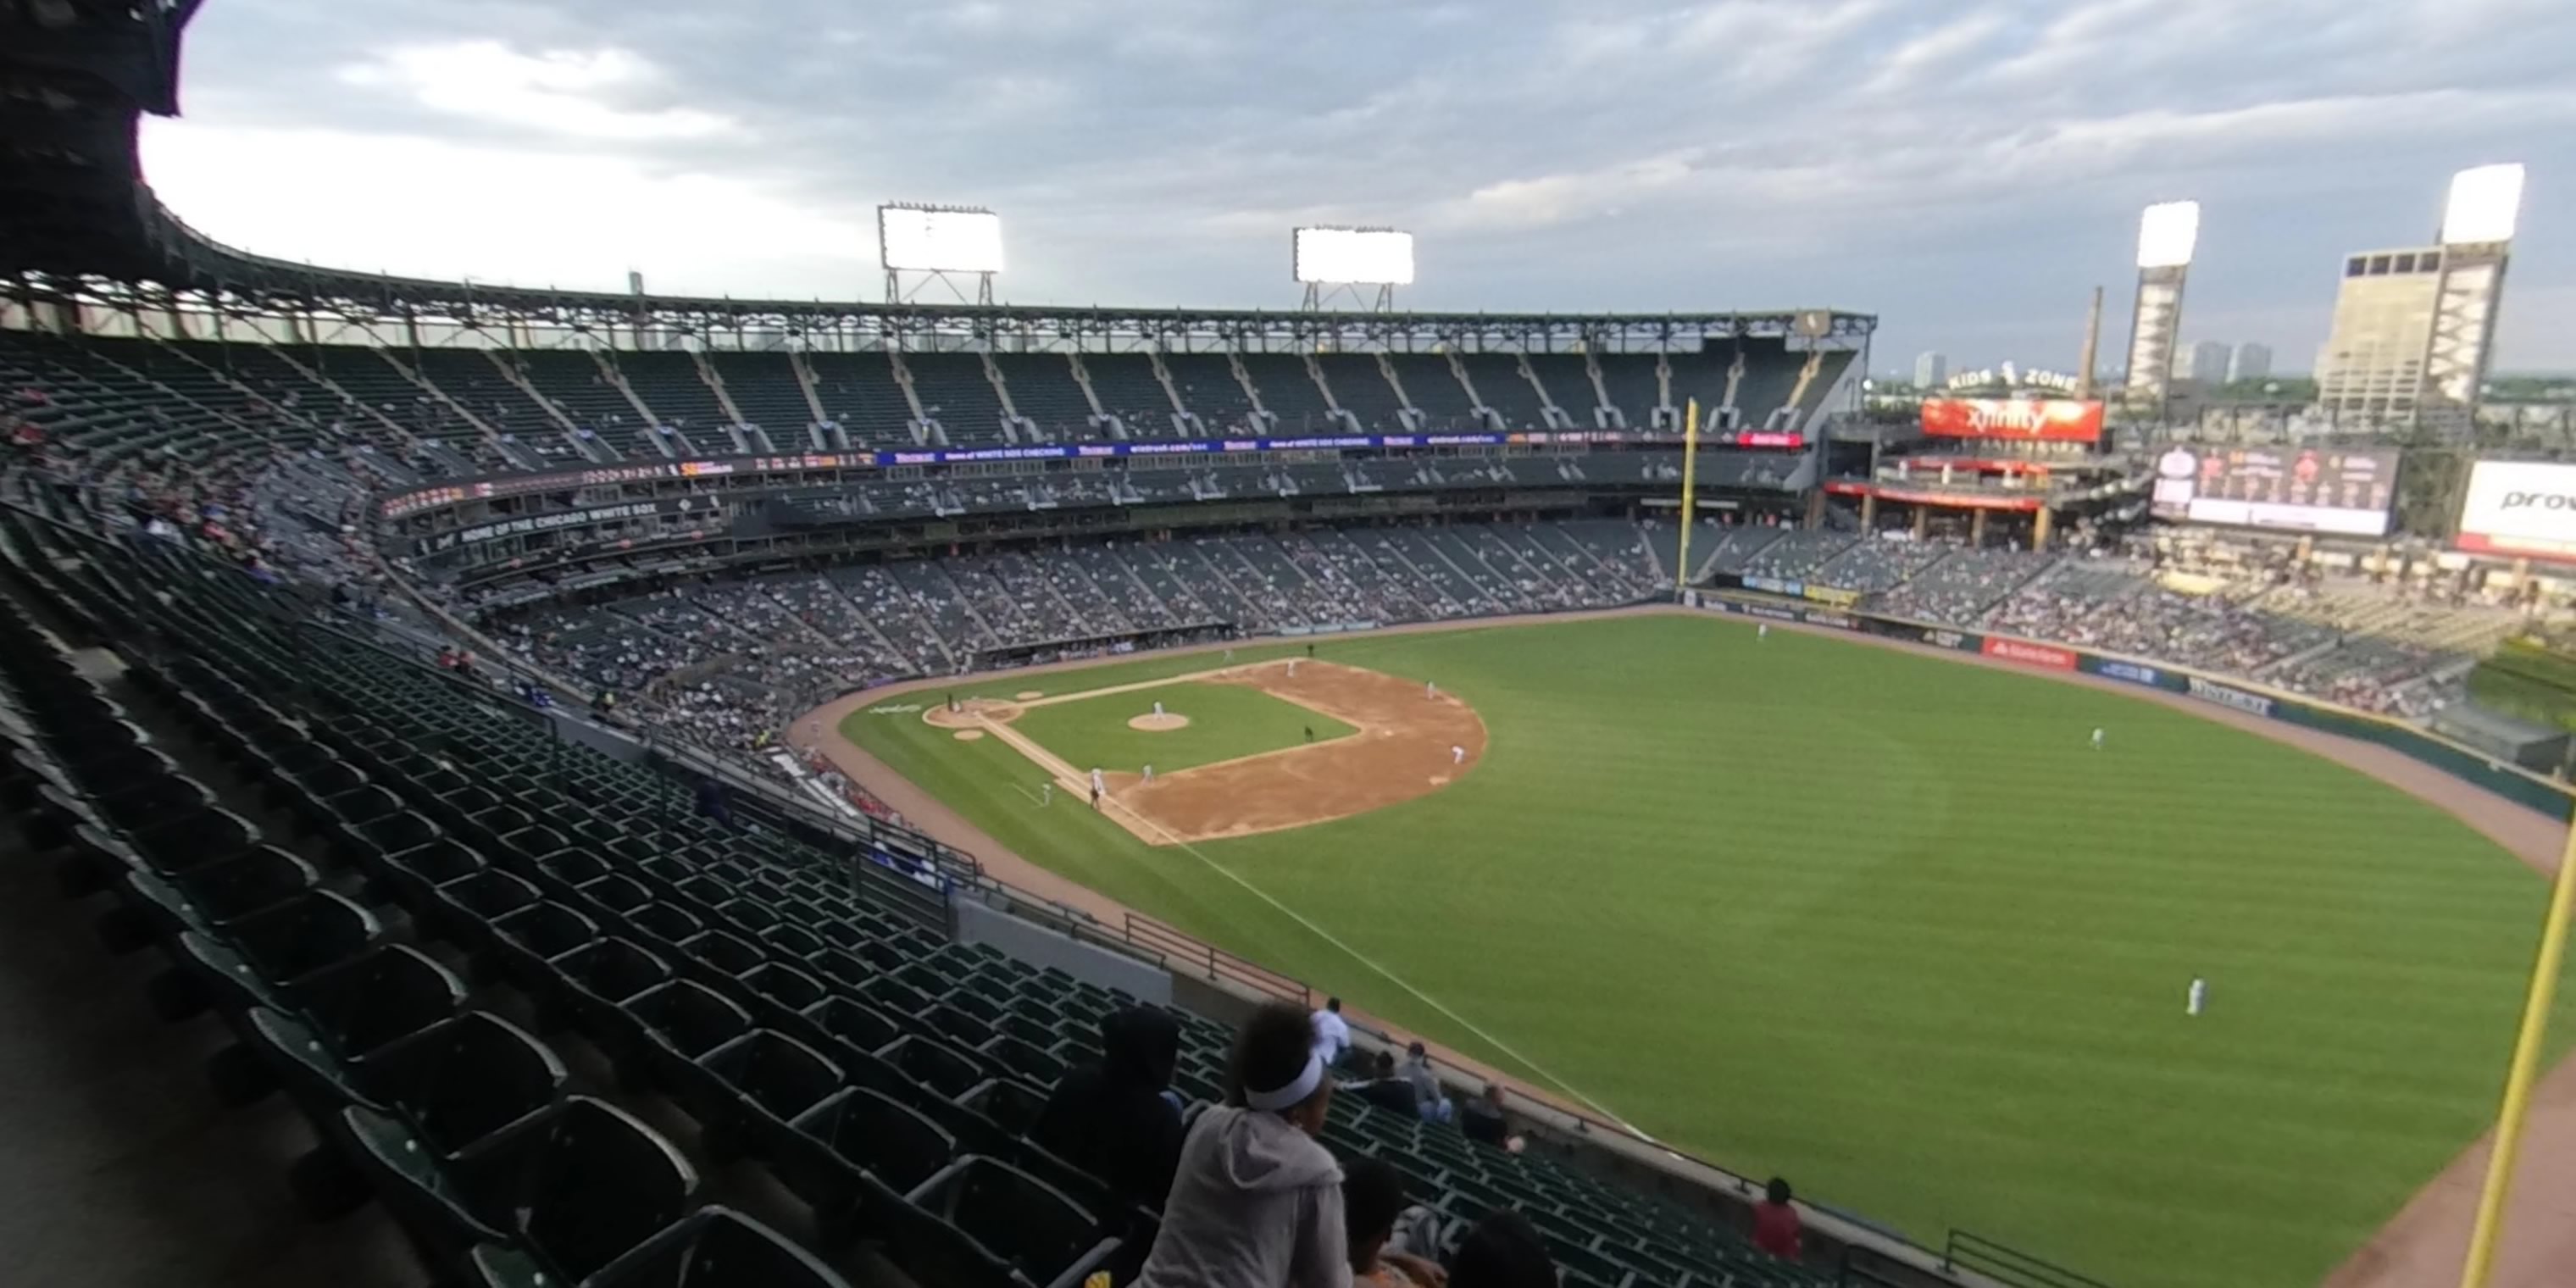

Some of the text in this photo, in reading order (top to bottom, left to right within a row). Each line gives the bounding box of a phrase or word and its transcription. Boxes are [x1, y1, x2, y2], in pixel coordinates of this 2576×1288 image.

[1948, 368, 2077, 391] KIDS ZONE
[1965, 402, 2048, 434] xfinity
[975, 449, 1003, 459] WHITE
[462, 502, 658, 542] HOME OF THE CHICAGO WHITE SOX
